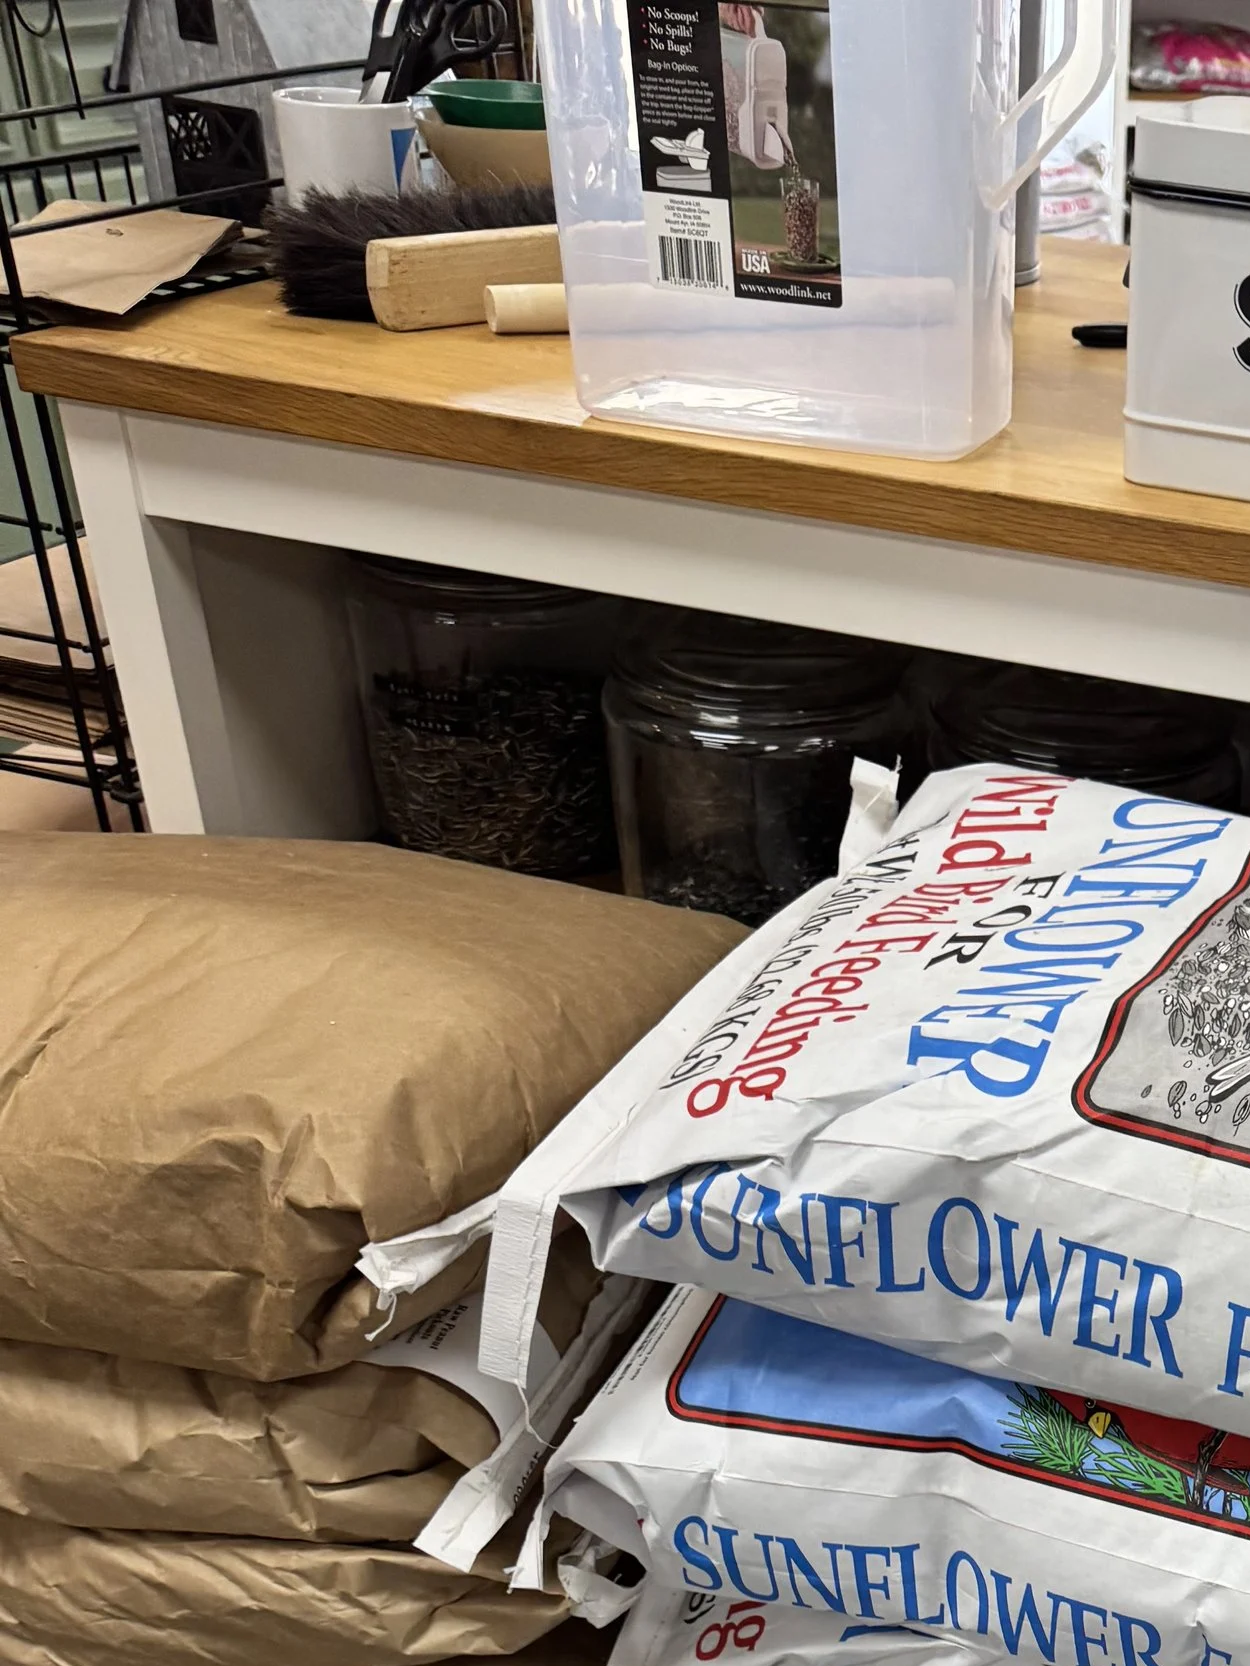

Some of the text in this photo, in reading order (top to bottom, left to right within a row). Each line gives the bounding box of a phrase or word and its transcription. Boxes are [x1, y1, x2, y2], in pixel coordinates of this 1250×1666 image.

[647, 6, 700, 25] No Scoops!
[648, 22, 693, 39] No Spills!
[650, 38, 692, 56] No Bugs!
[742, 254, 771, 274] USA
[740, 283, 832, 300] www.woodlink.net
[924, 871, 1066, 970] FOR
[687, 775, 1078, 1119] Wild Bird Feeding
[907, 798, 1233, 1097] UNFLOWER
[639, 1162, 1184, 1378] SUNFLOWER
